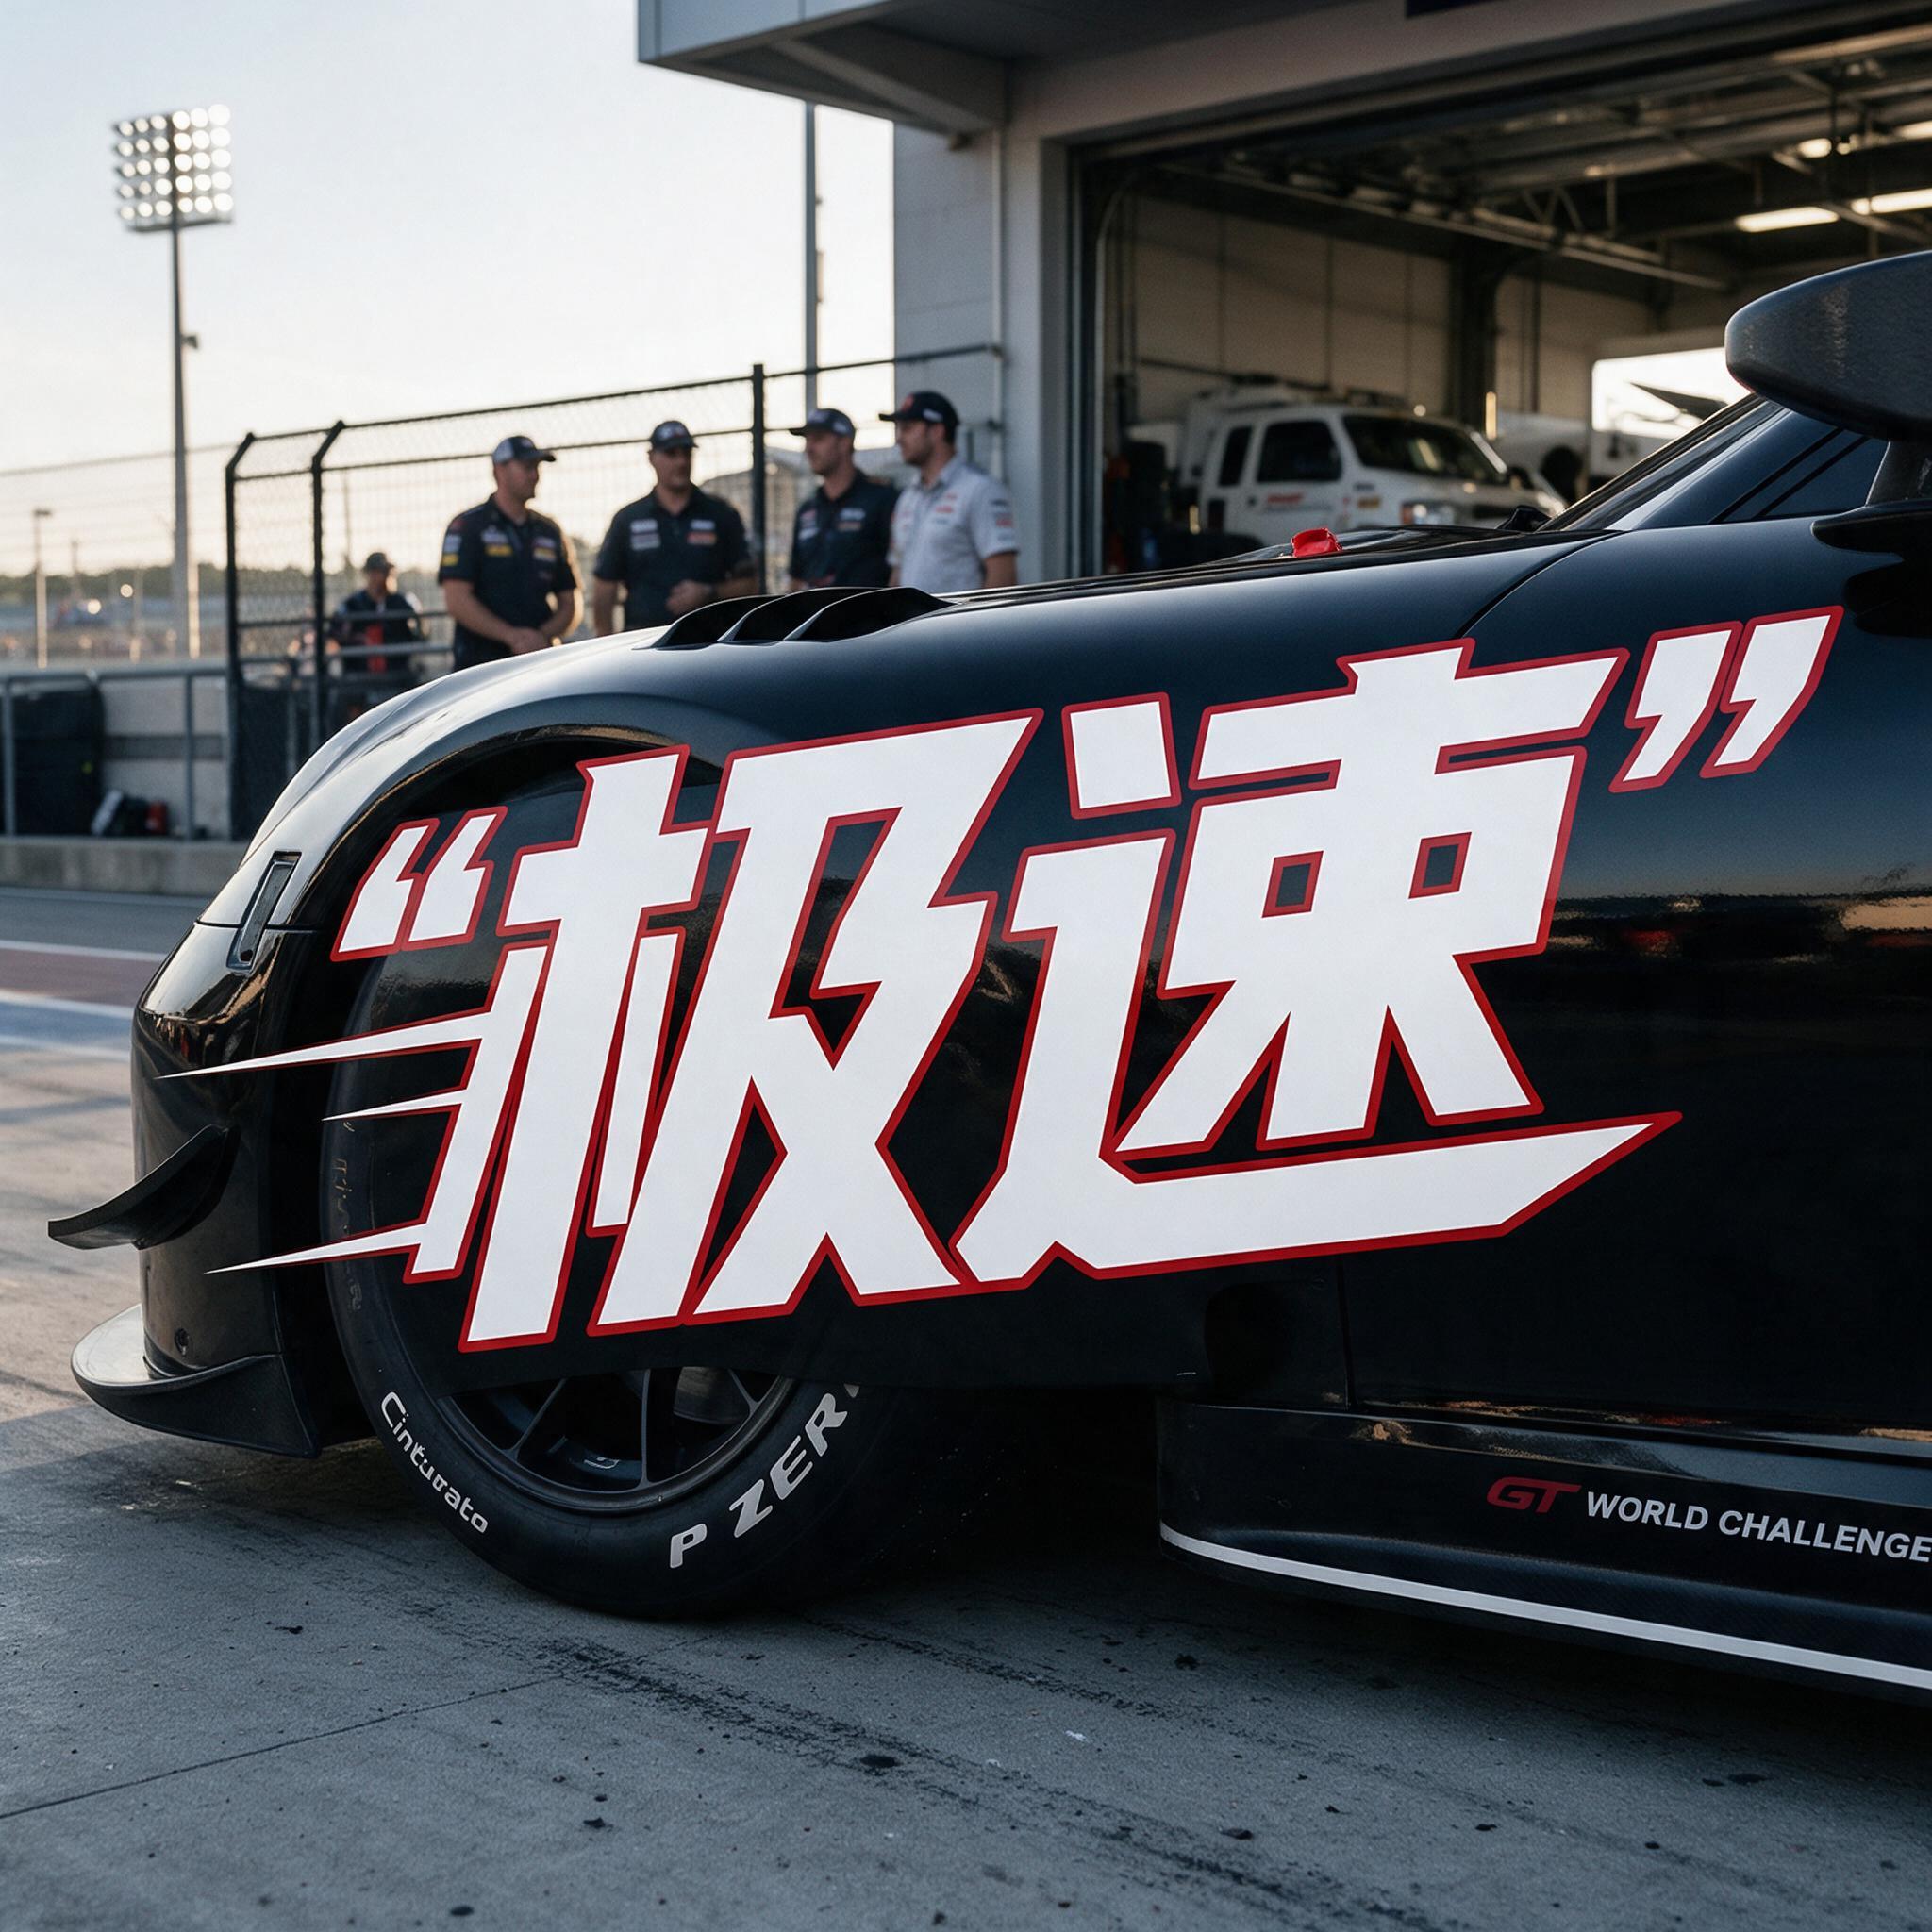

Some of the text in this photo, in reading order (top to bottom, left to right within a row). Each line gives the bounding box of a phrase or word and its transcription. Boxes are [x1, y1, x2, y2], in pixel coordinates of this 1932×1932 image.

[670, 1384, 860, 1569] P ZER
[1486, 1476, 1932, 1563] GT WORLD CHALLENGE
